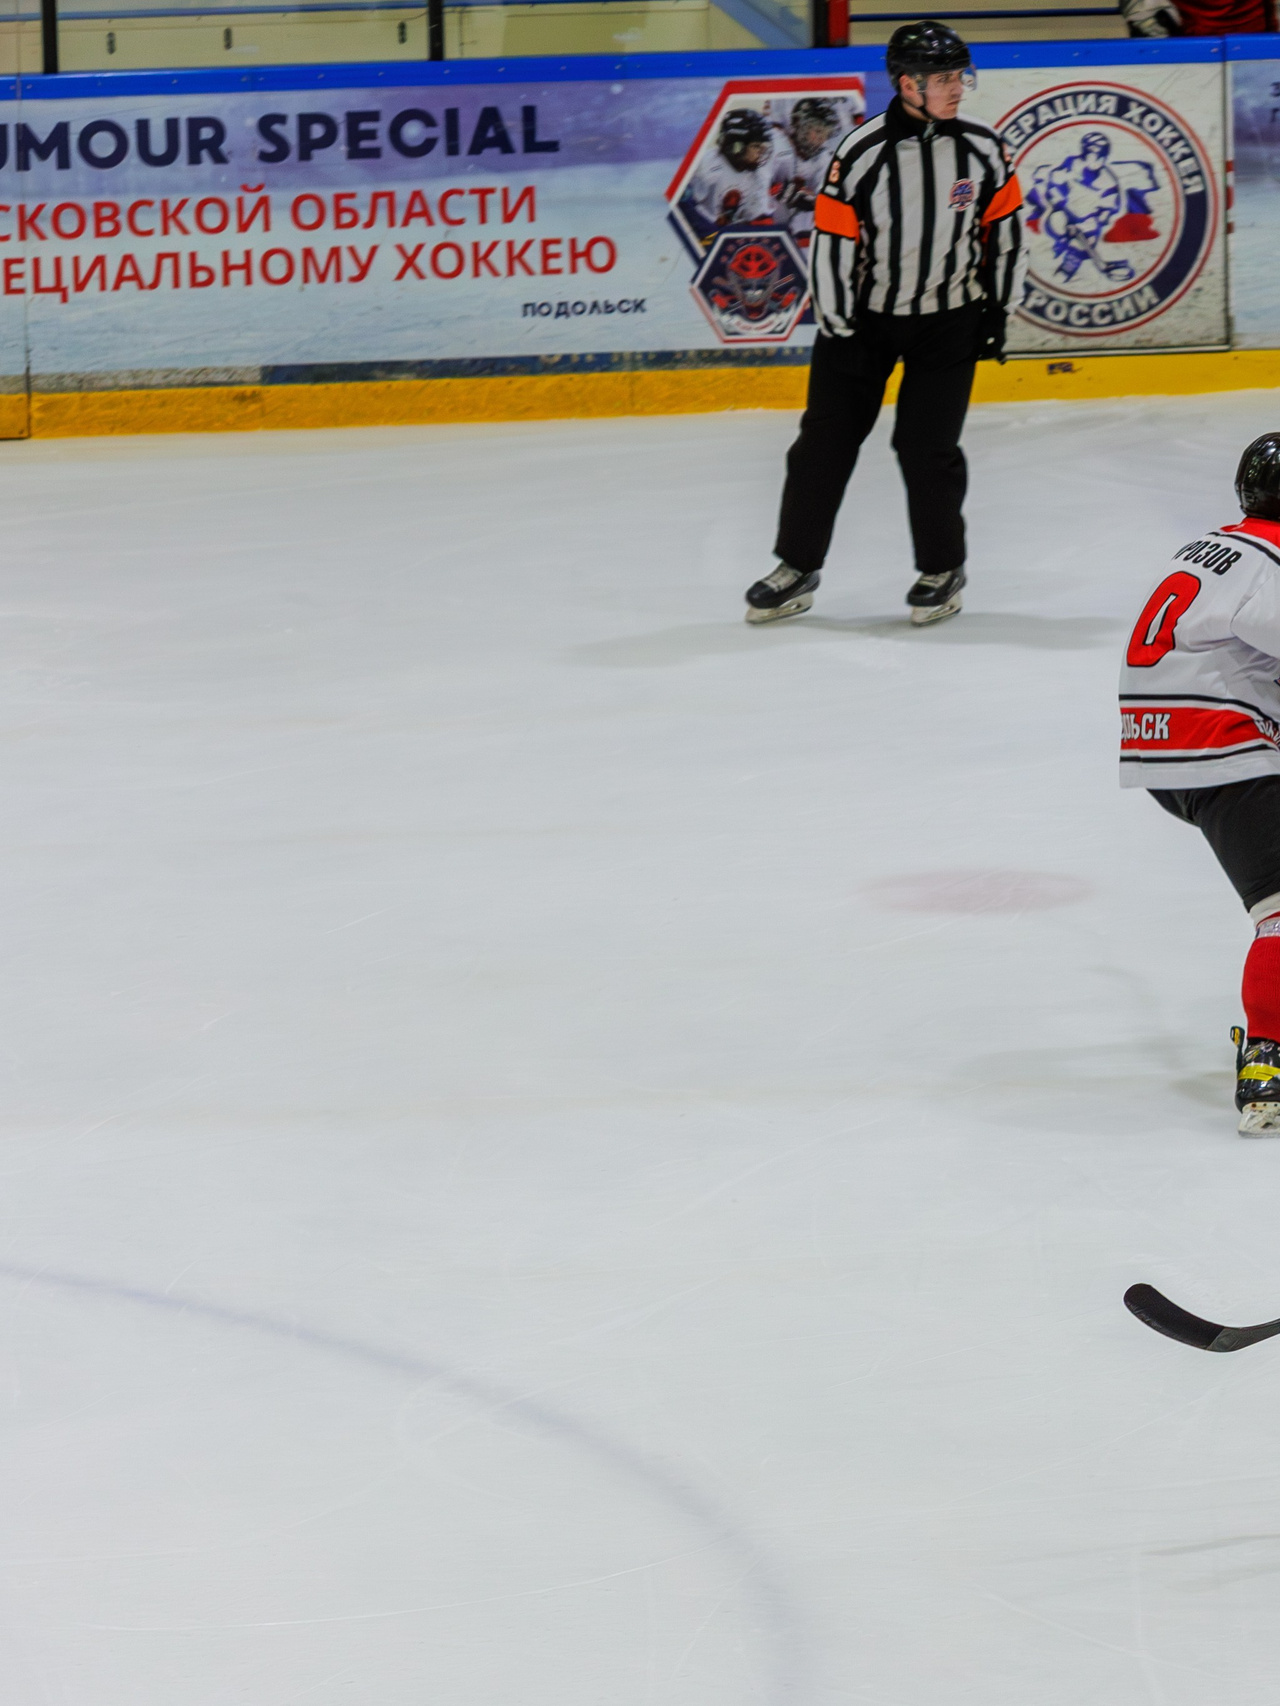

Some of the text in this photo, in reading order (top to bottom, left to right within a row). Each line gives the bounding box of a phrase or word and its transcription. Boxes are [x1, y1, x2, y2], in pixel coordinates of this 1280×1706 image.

[0, 105, 559, 172] MOUR SPECIAL
[1003, 93, 1205, 195] ЕРАЦИЯ ХОККЕЯ
[290, 185, 536, 232] ОБЛАСТИ
[393, 236, 618, 281] ХОККЕЮ
[522, 298, 647, 319] ПОДОЛЬСК
[1024, 285, 1160, 326] РОССИИ
[1171, 540, 1242, 576] РОЗОВ
